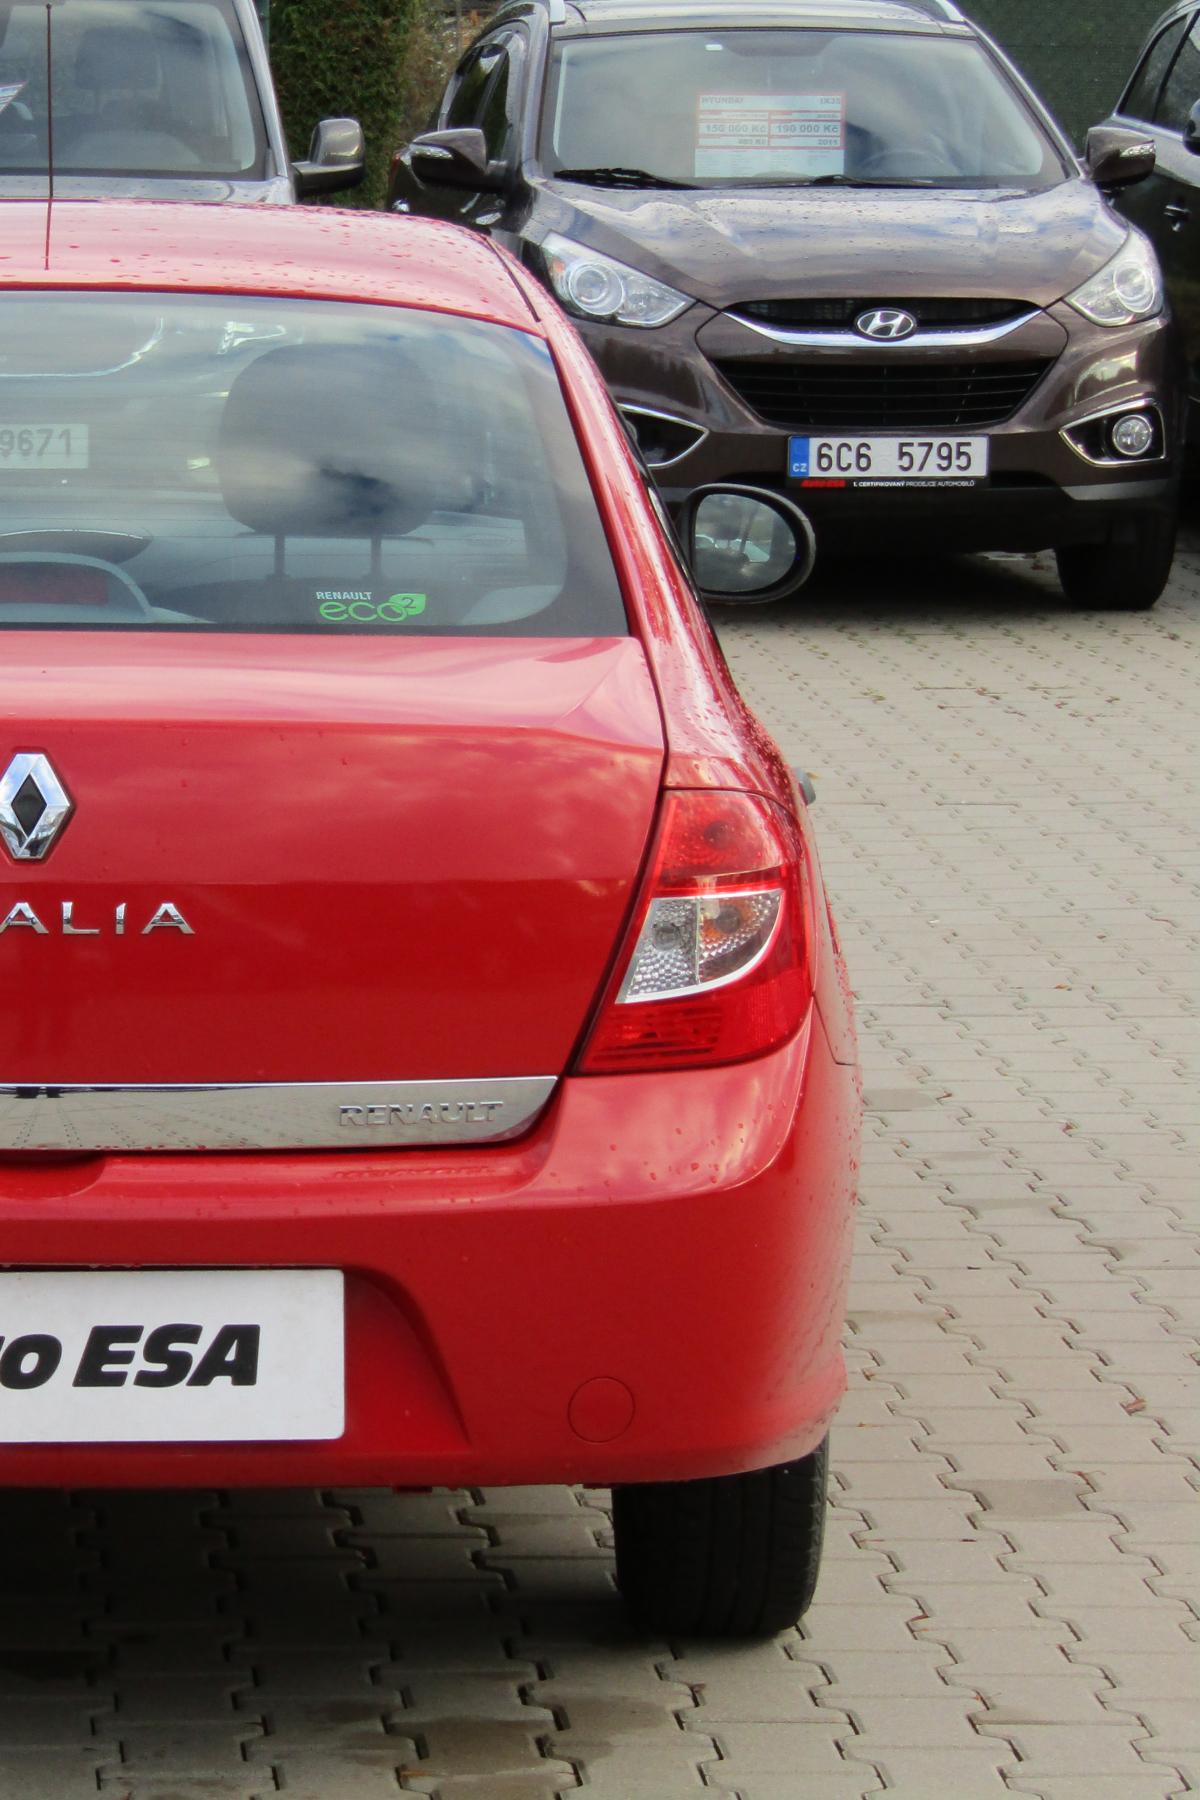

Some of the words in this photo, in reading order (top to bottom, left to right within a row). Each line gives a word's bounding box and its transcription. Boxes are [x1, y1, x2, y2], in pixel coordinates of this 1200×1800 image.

[800, 124, 820, 133] 000
[0, 428, 72, 457] 9671
[792, 463, 807, 473] CZ
[816, 442, 872, 472] 6C6
[898, 442, 972, 472] 5795
[315, 591, 372, 600] RENAULT
[339, 1101, 504, 1126] RENAULT
[72, 1323, 261, 1388] ESA
